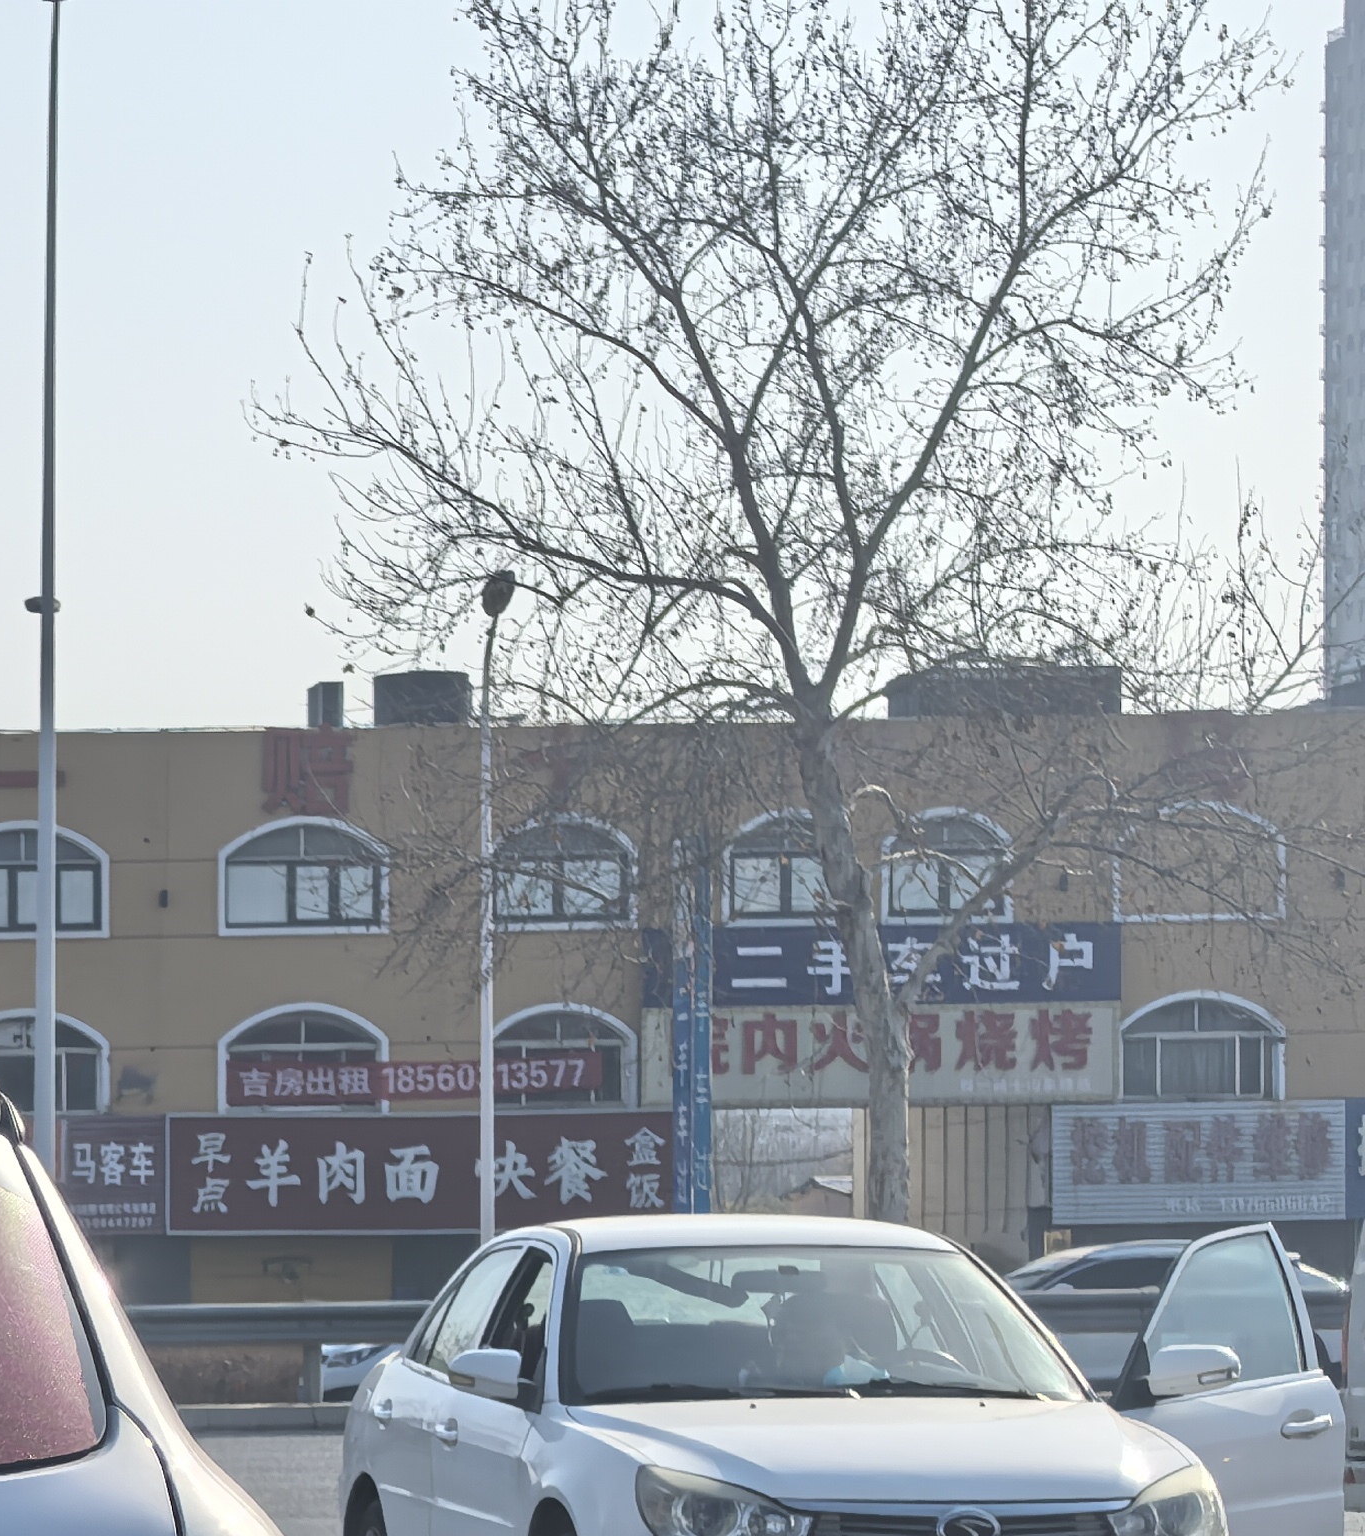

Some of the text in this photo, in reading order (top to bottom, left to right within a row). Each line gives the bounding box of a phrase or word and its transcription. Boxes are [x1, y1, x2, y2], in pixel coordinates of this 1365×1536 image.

[731, 933, 1094, 996] 二手车过户
[239, 1058, 586, 1097] 吉房出租 1856013577
[191, 1132, 230, 1214] 早点
[245, 1136, 608, 1207] 羊肉面 快餐
[624, 1126, 666, 1209] 盒饭
